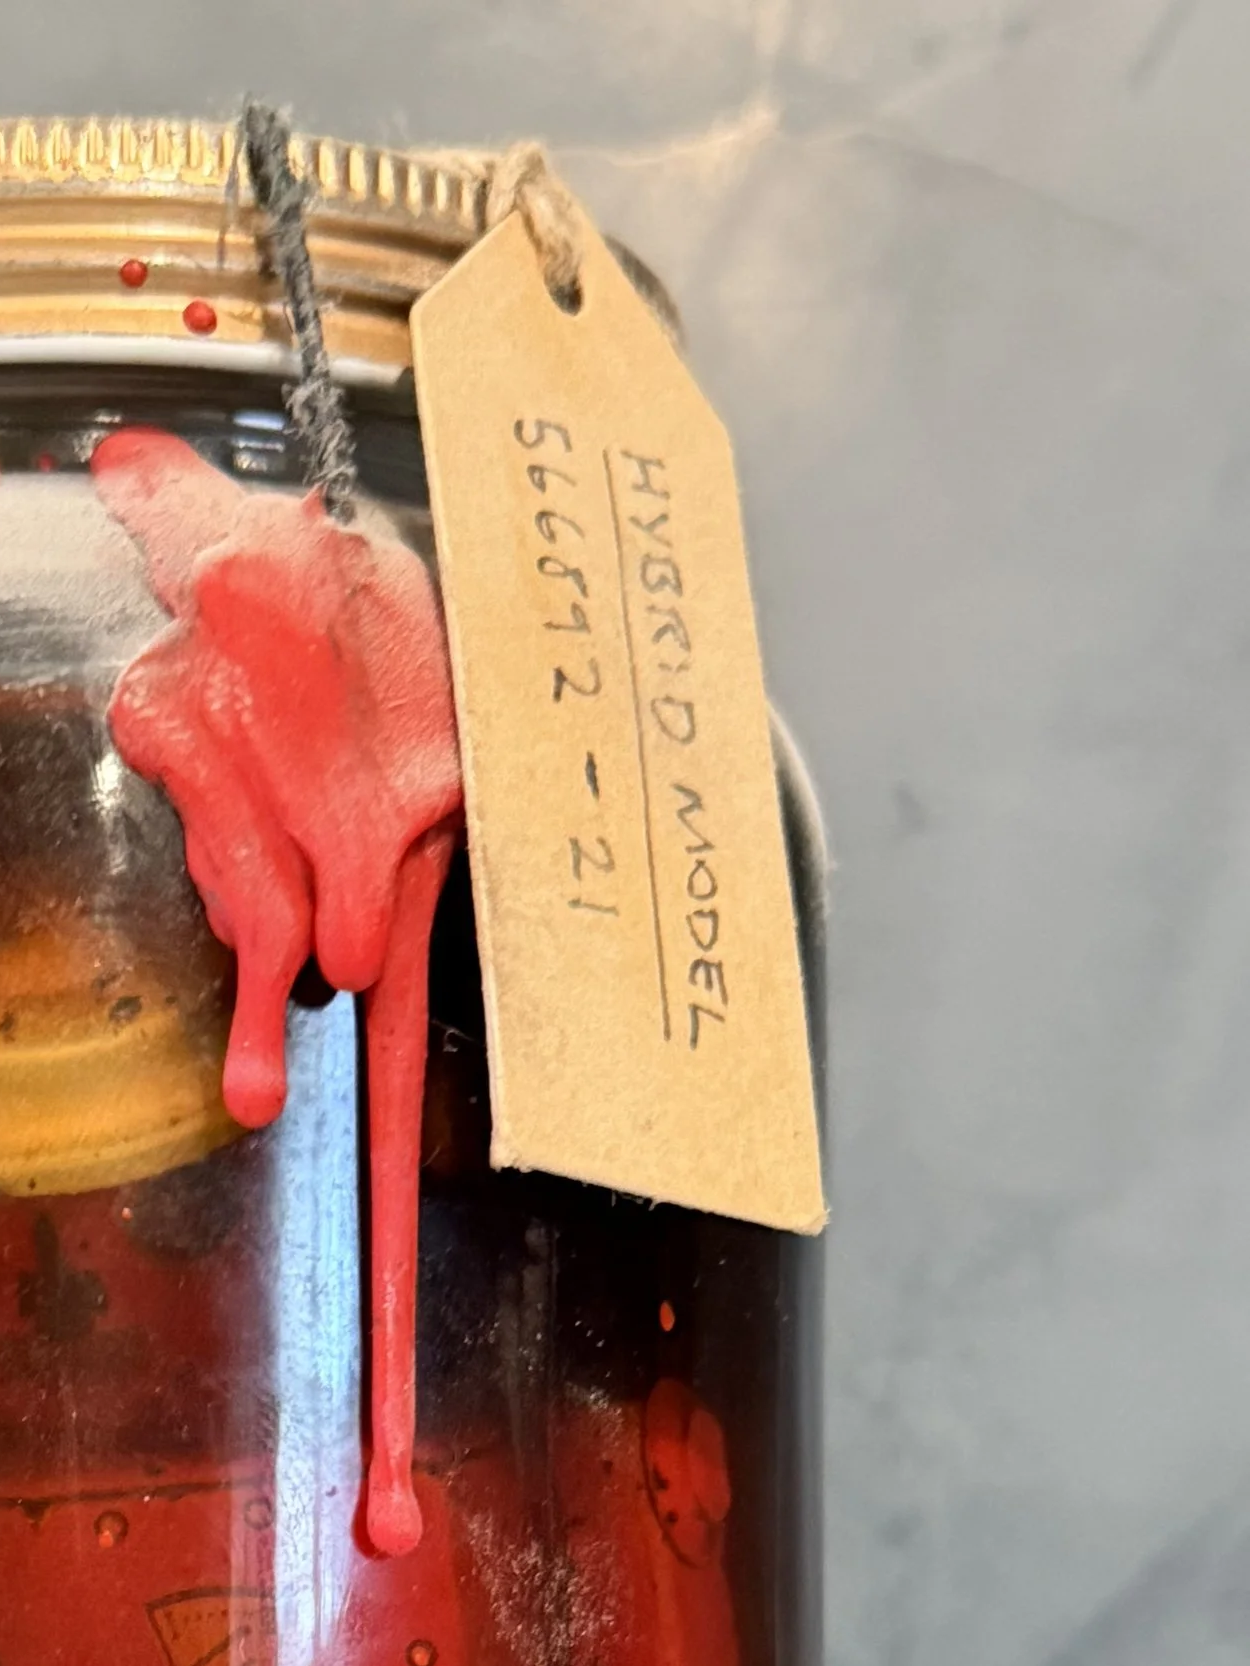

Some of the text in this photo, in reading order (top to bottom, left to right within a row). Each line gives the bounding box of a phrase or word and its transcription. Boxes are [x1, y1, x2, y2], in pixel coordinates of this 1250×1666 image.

[568, 834, 620, 918] 21
[620, 447, 729, 1050] HYBRID MODEL
